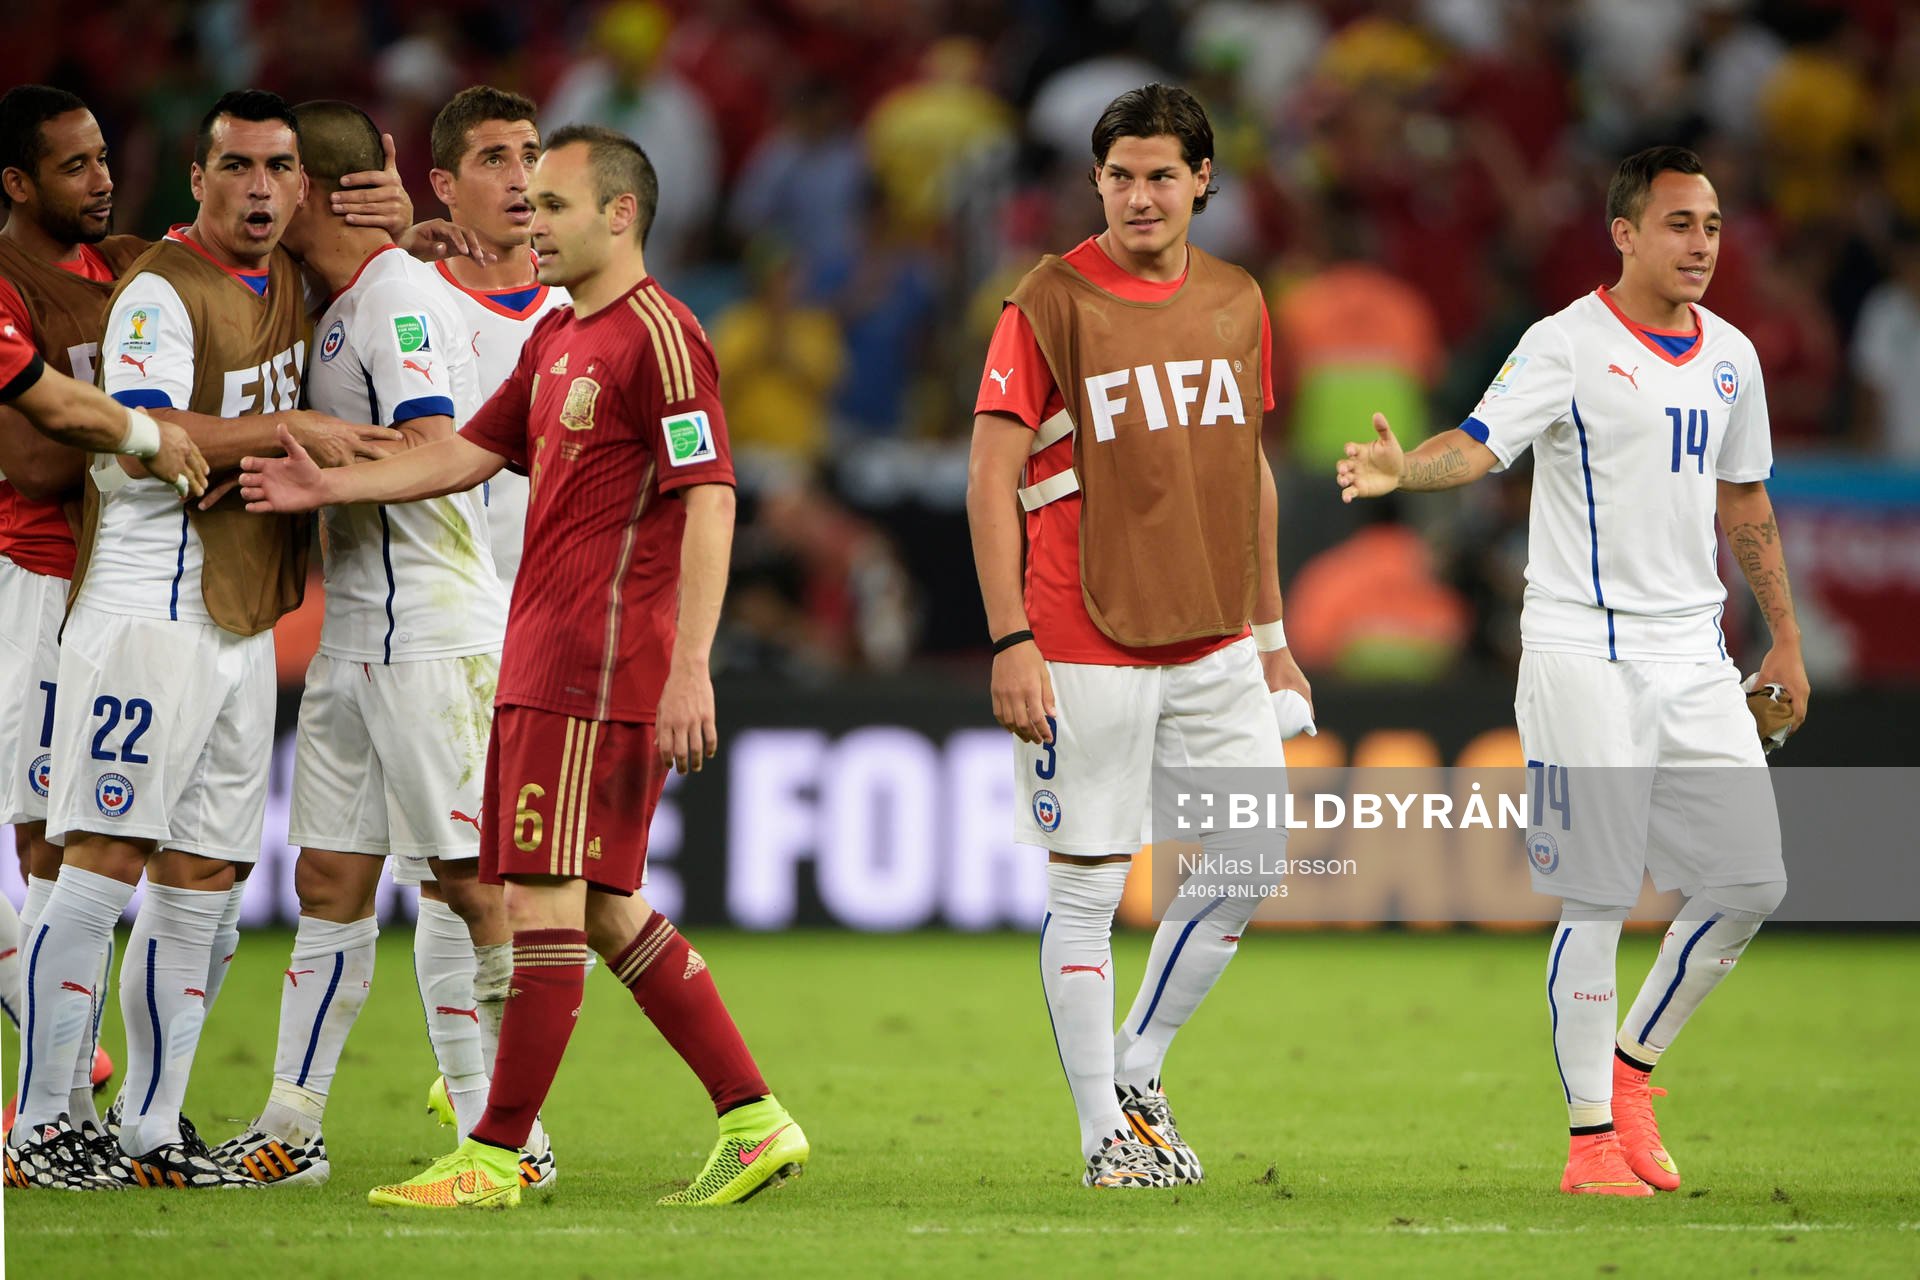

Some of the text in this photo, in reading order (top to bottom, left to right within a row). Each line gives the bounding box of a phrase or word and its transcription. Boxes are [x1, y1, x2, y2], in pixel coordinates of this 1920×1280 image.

[1665, 407, 1709, 474] 14
[91, 695, 152, 764] 22
[513, 783, 545, 851] 6
[1527, 760, 1571, 831] 14
